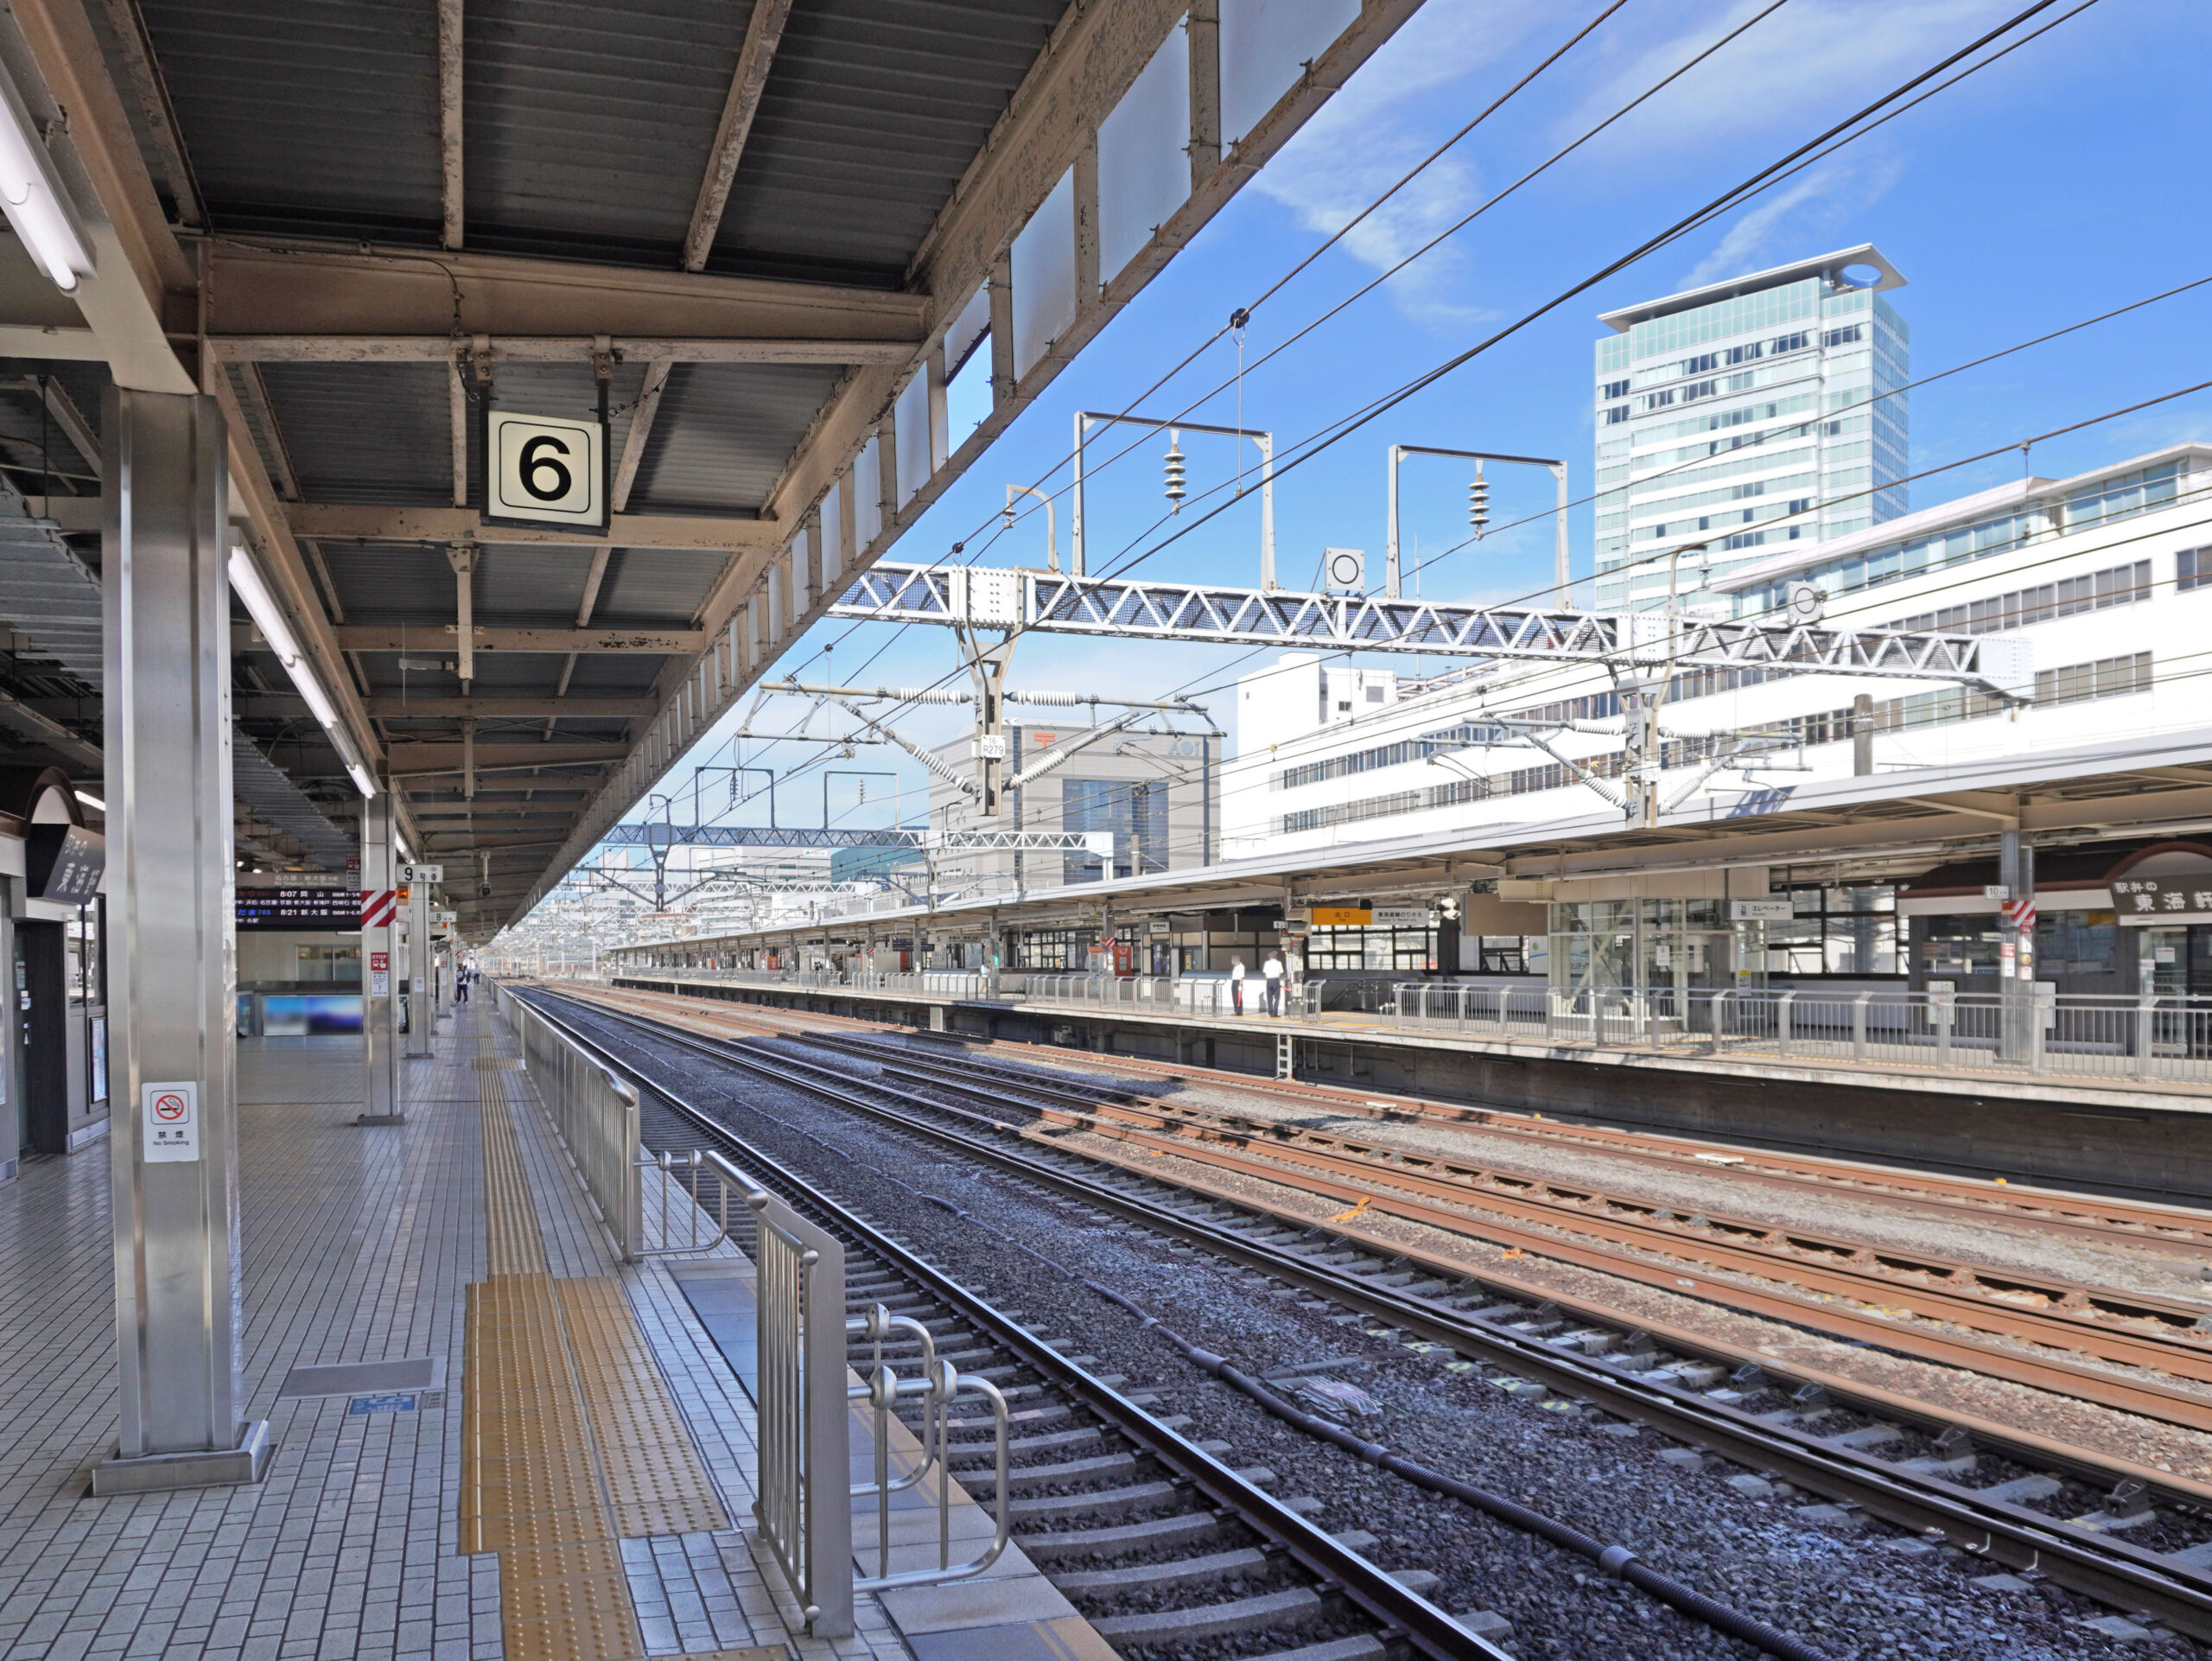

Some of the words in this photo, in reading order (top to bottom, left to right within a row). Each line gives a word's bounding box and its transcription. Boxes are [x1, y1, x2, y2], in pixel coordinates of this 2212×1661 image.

[519, 436, 571, 501] 6
[982, 745, 1003, 754] R279
[404, 867, 413, 881] 9
[1989, 887, 1999, 895] 10
[2115, 881, 2158, 894] 駅弁の
[435, 913, 442, 921] 8
